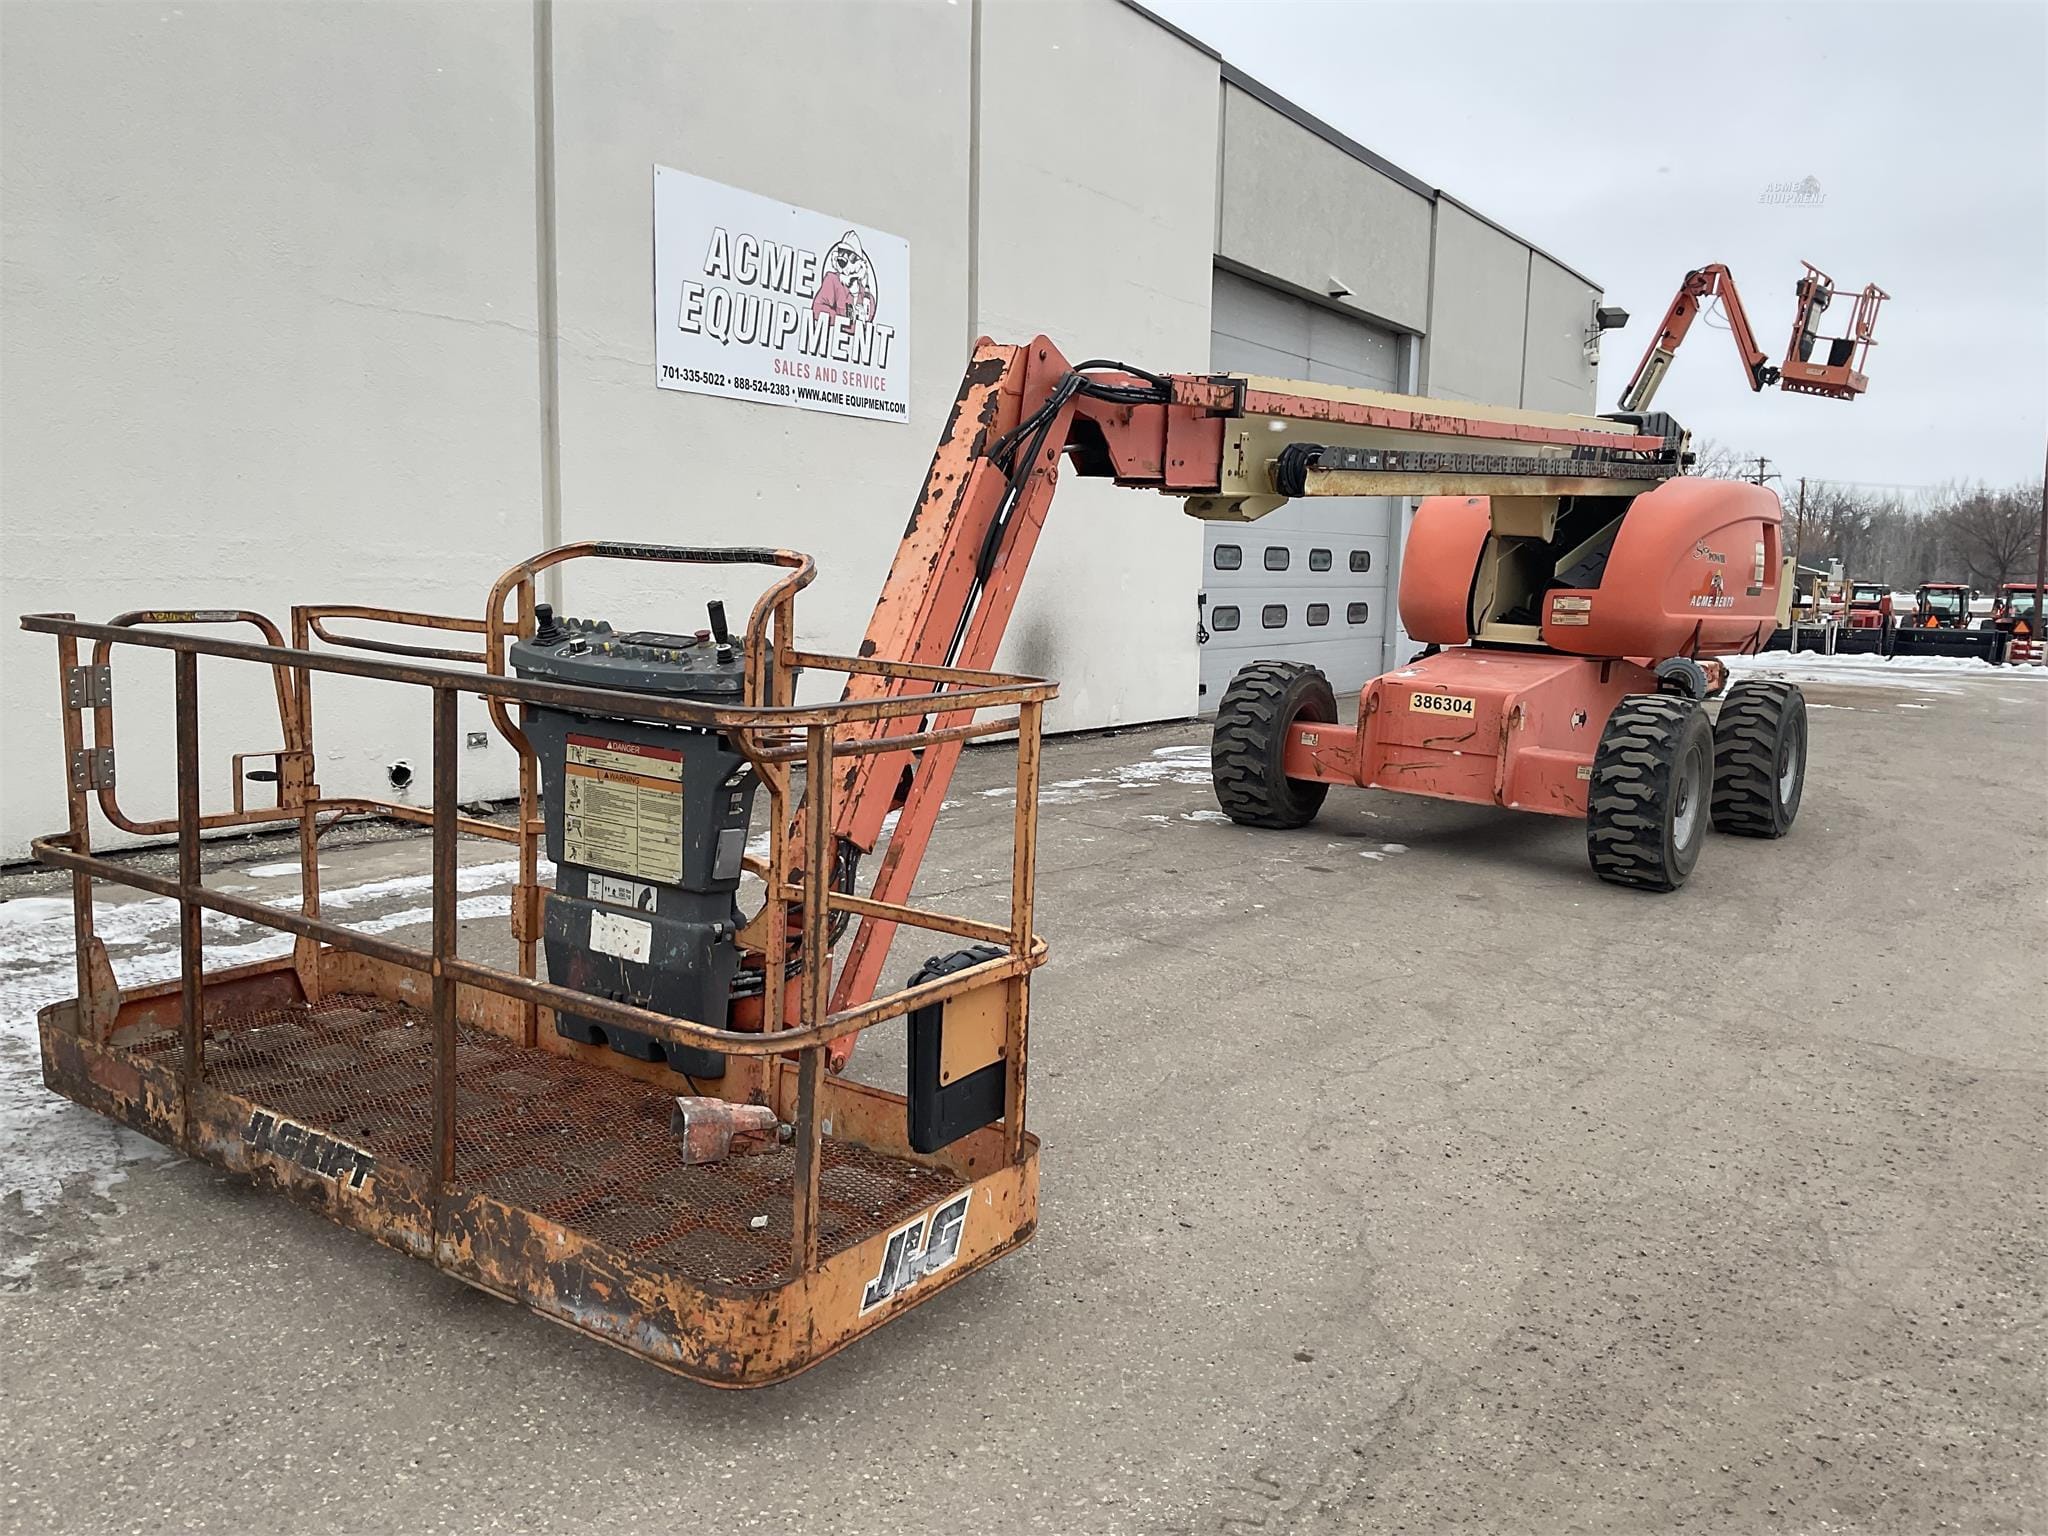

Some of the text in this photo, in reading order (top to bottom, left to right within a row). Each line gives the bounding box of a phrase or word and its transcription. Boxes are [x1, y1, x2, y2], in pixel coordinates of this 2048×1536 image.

[703, 226, 817, 299] ACME
[678, 280, 895, 370] EQUIPMENT
[662, 365, 726, 386] 701-335-5022
[733, 377, 791, 397] 888-524-2383
[774, 358, 887, 392] SALES AND SERVICE
[1690, 595, 1735, 607] ACME RENTS
[1413, 694, 1473, 713] 386304
[612, 742, 640, 754] DANGER
[608, 773, 640, 785] WARNING
[859, 1187, 973, 1317] JLG
